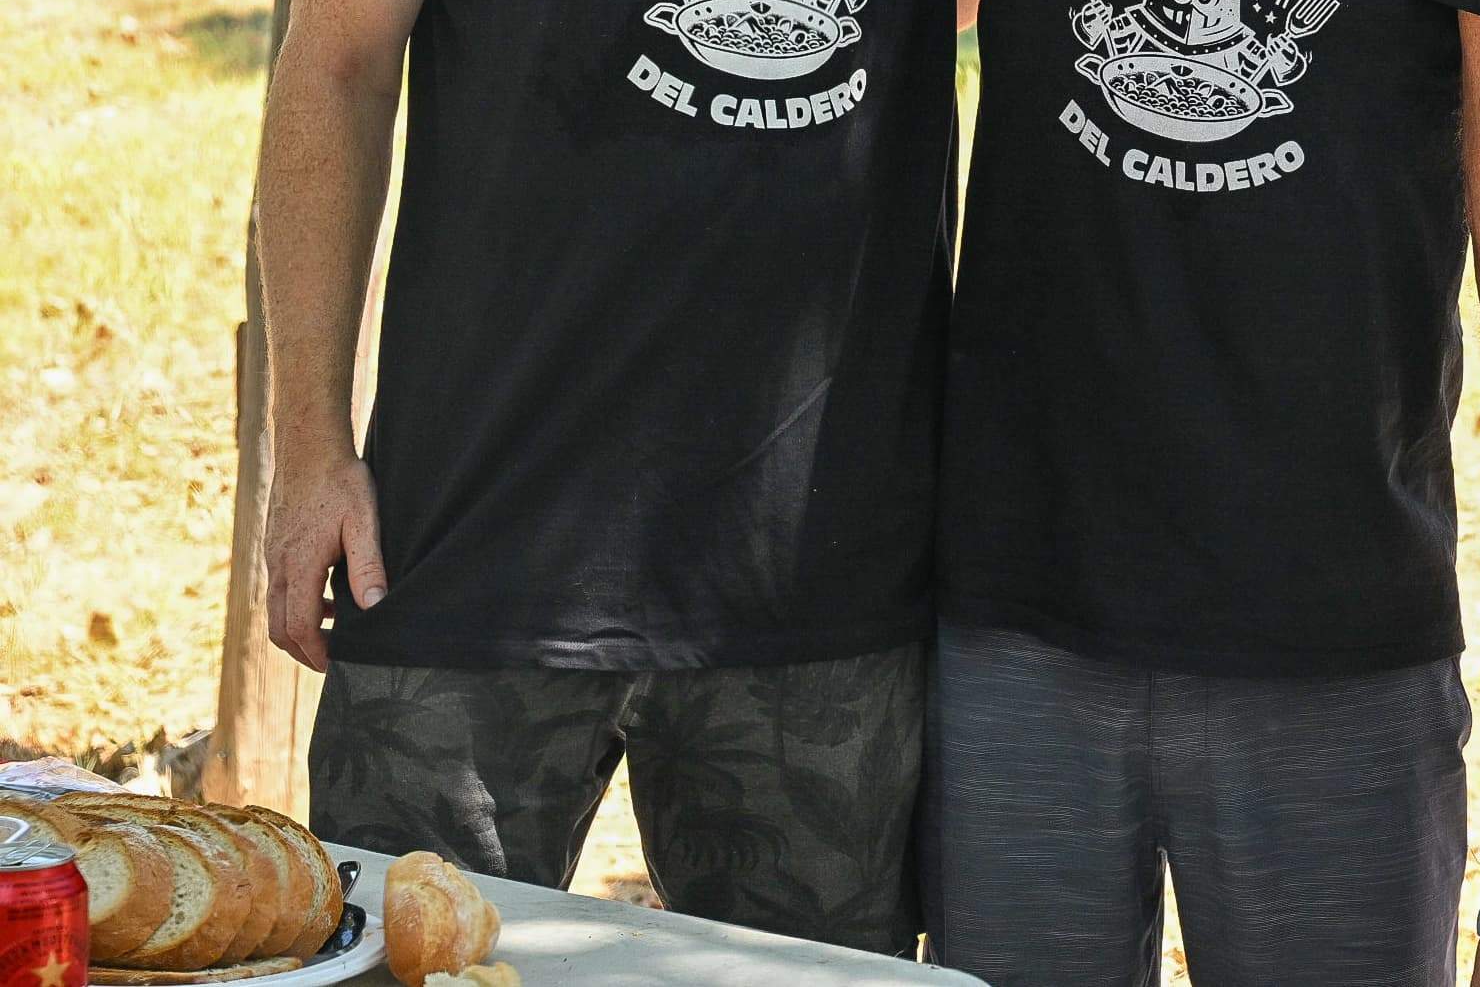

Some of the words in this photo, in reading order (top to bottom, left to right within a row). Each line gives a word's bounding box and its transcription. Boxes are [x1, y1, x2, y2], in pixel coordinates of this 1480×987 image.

[626, 54, 698, 118] DEL
[710, 68, 867, 129] CALDERO
[1058, 99, 1111, 167] DEL
[1122, 140, 1305, 192] CALDERO
